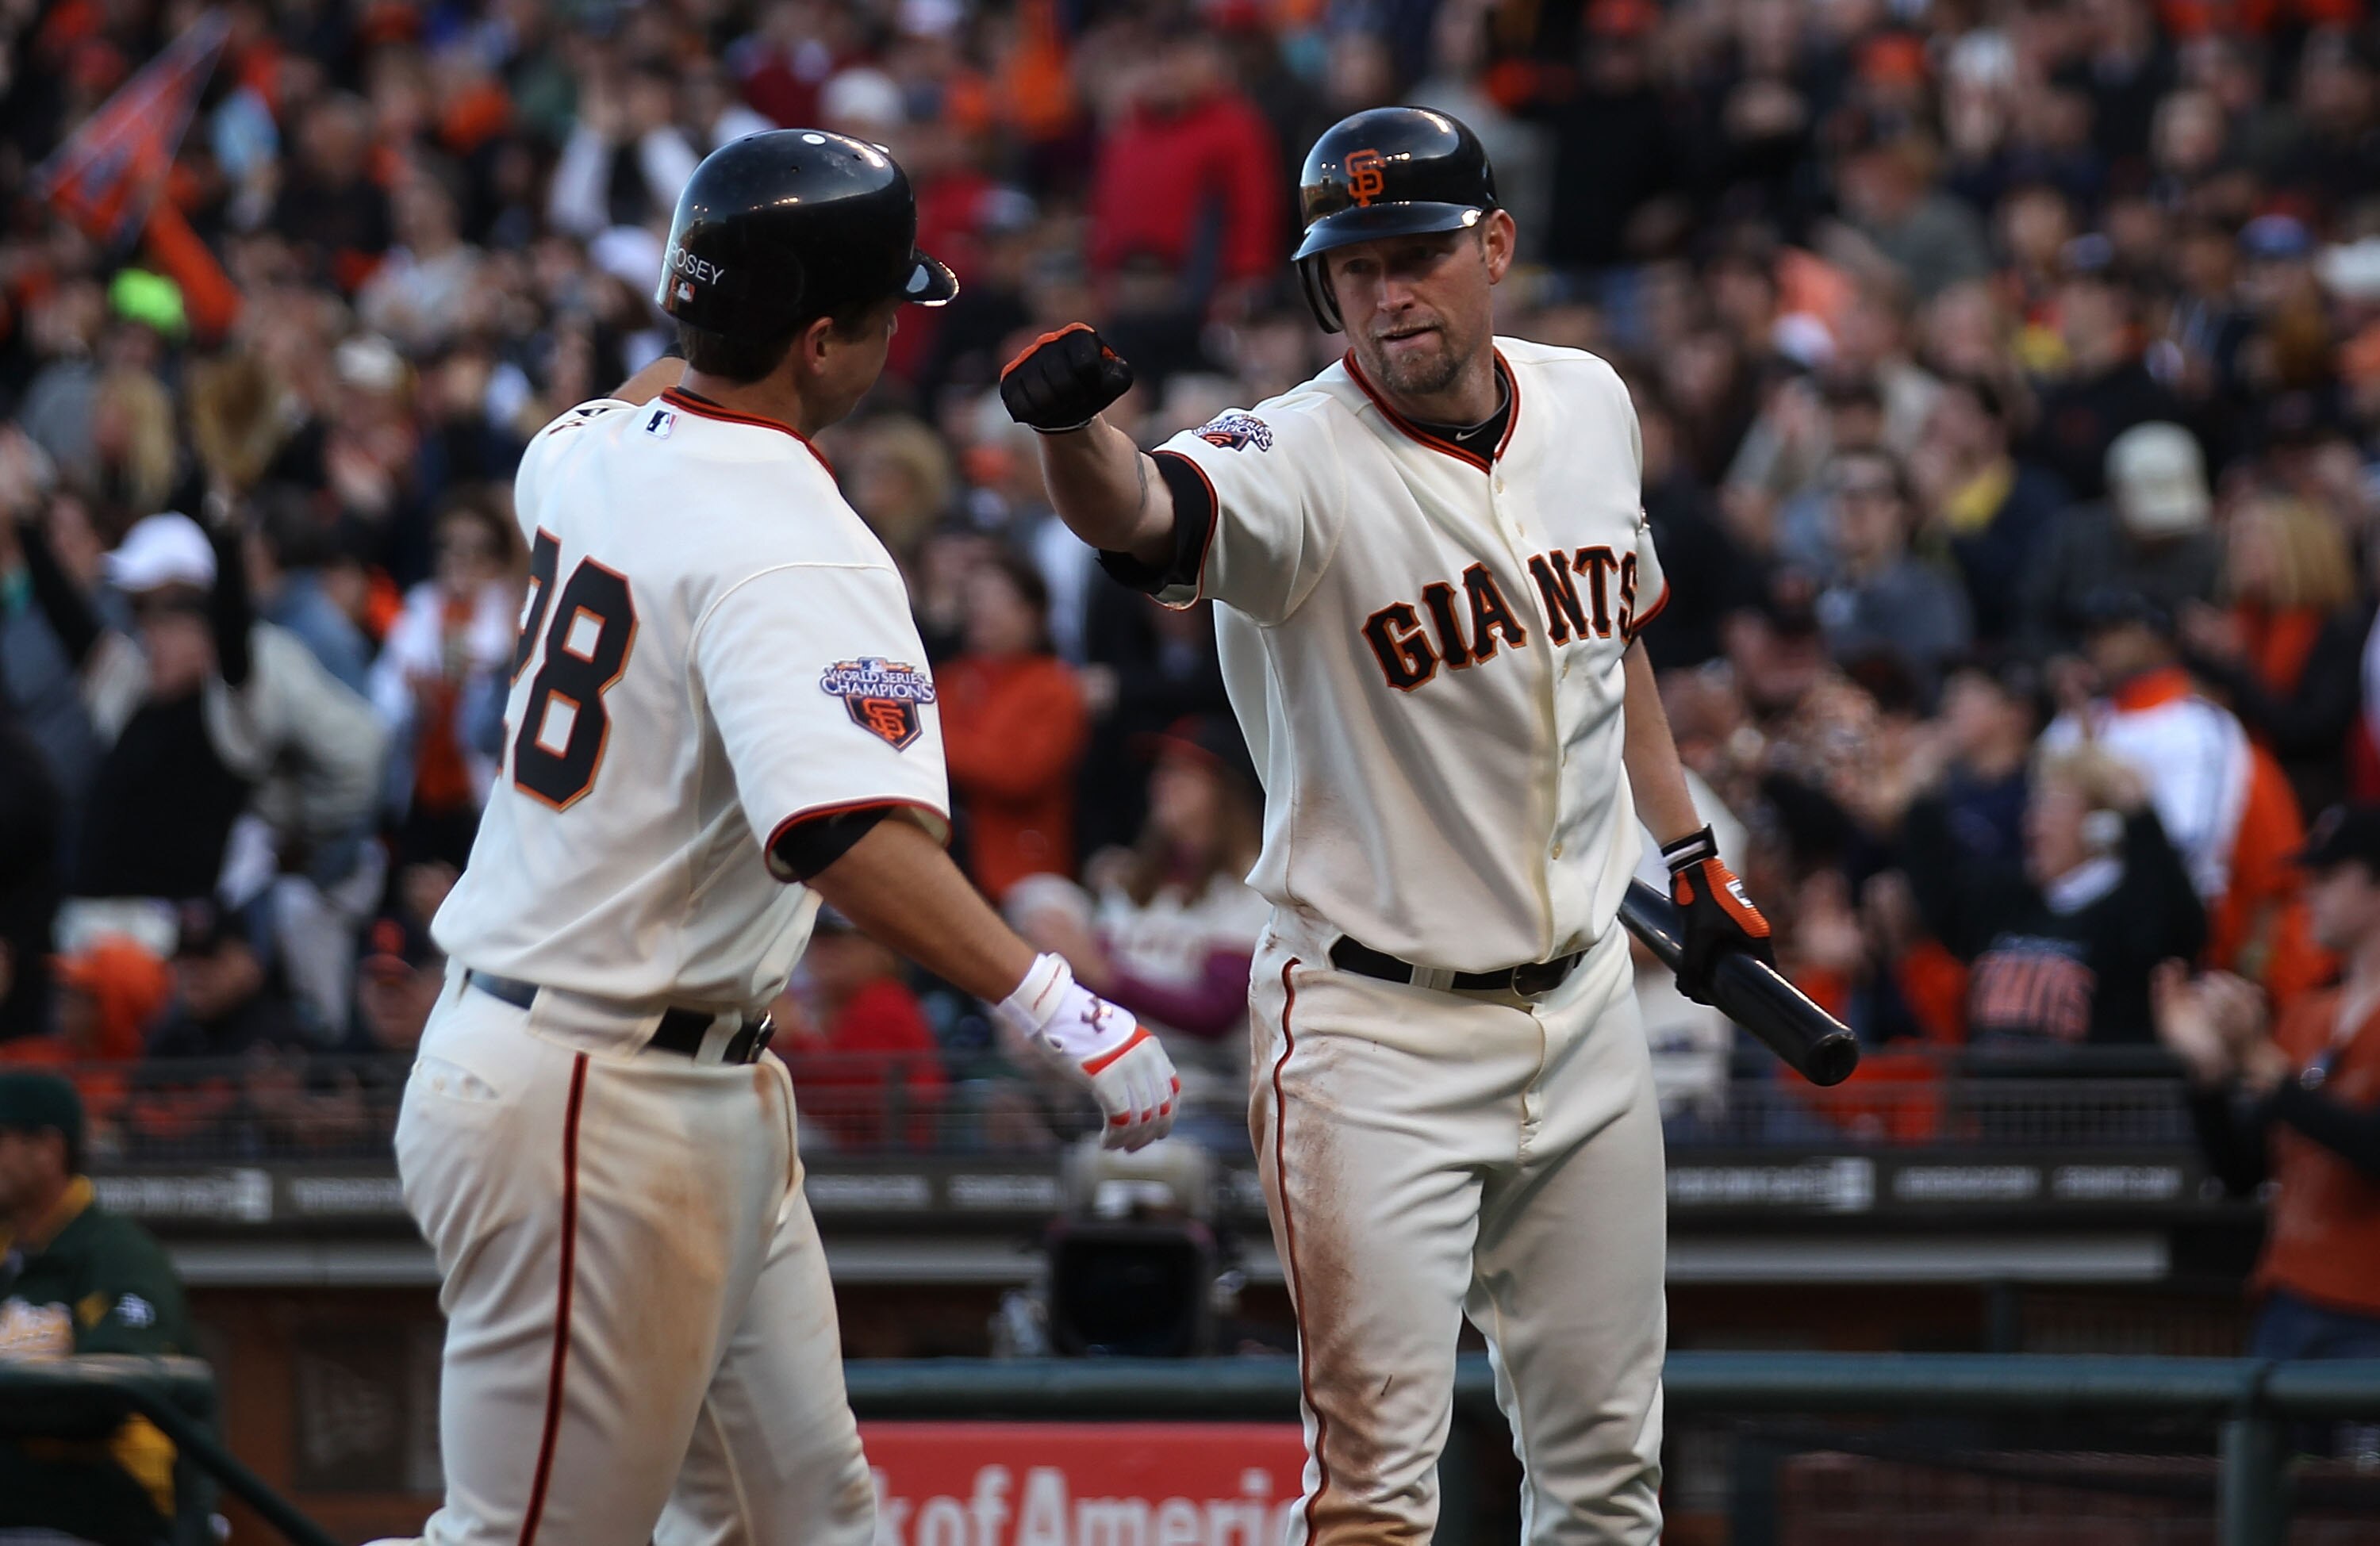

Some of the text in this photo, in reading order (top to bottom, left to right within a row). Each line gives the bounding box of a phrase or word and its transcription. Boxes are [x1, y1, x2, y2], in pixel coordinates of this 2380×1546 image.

[669, 241, 724, 285] POSEY
[1361, 544, 1639, 693] GIANTS
[820, 675, 935, 702] CHAMPIONS
[824, 666, 926, 685] WORLD SERIES
